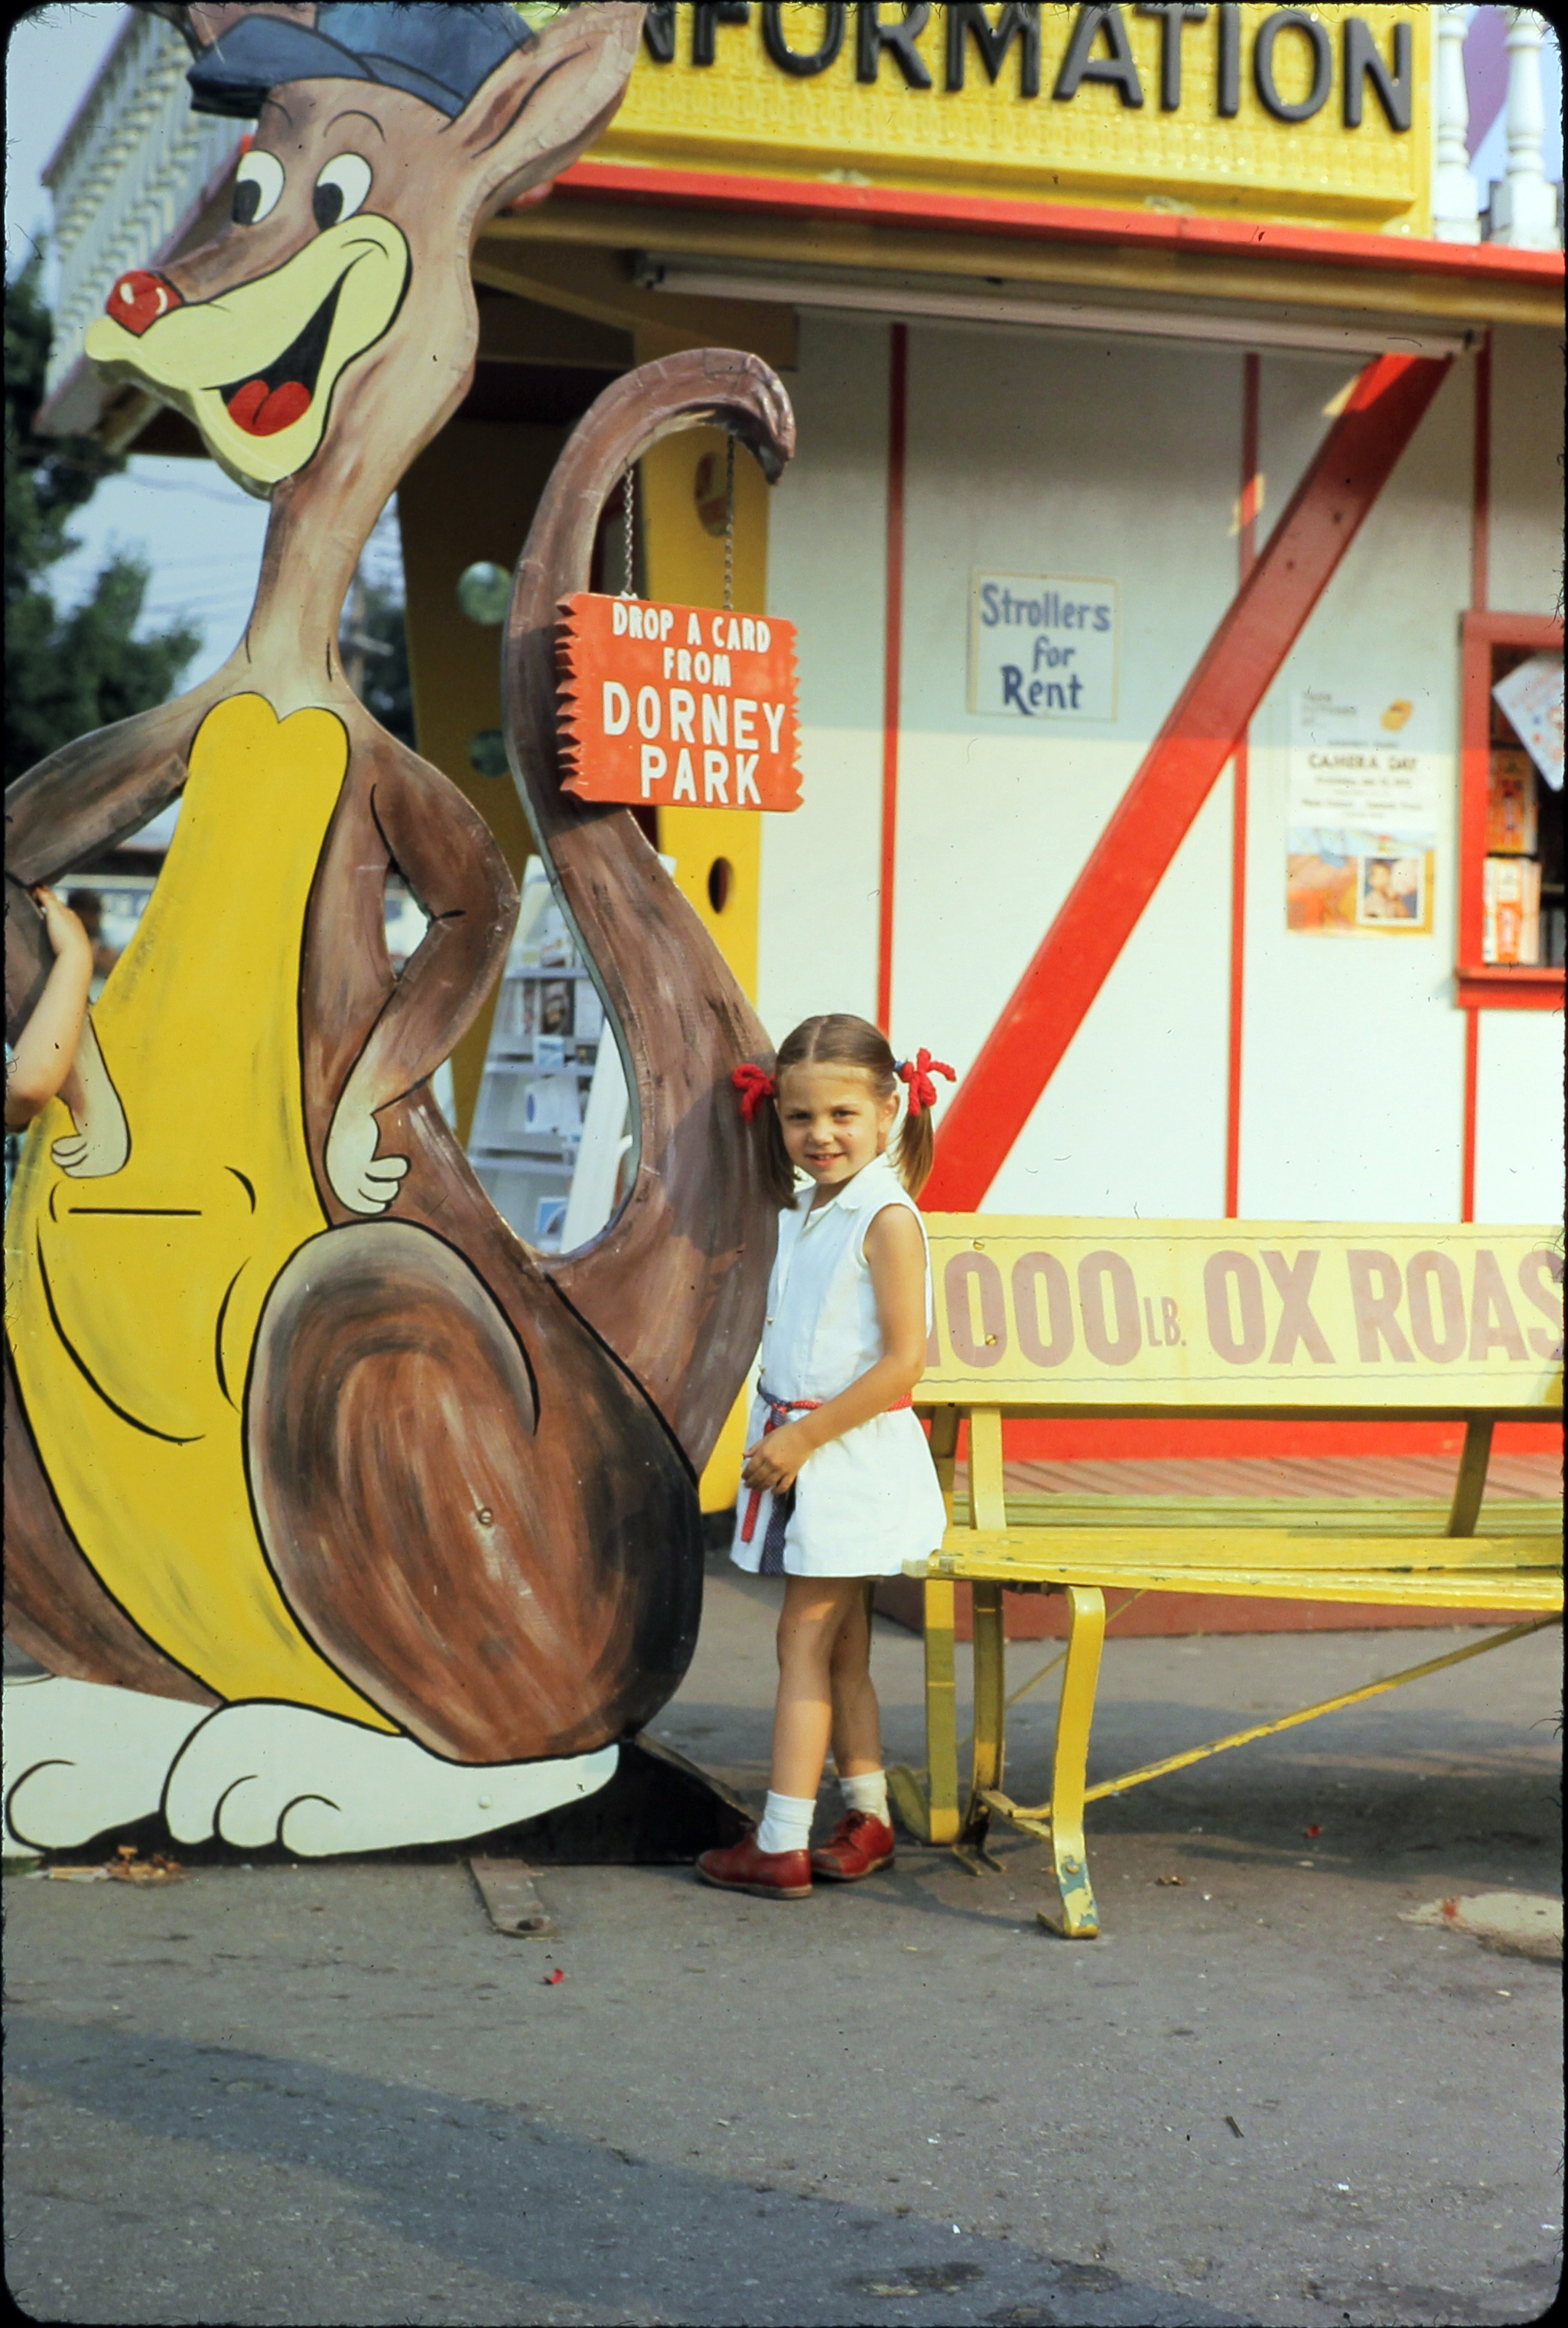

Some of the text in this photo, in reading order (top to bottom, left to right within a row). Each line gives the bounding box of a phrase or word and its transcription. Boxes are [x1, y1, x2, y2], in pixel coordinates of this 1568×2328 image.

[642, 2, 1412, 133] FORMATION
[613, 601, 771, 653] DROP A CARD
[981, 582, 1111, 632] Strollers
[663, 646, 731, 687] FROM
[1032, 633, 1076, 673] for
[1000, 664, 1083, 716] Rent
[603, 680, 786, 754] DORNEY
[641, 743, 762, 805] PARK
[1143, 1297, 1187, 1346] LB.
[1203, 1249, 1336, 1365] OX
[1346, 1249, 1563, 1364] ROAS
